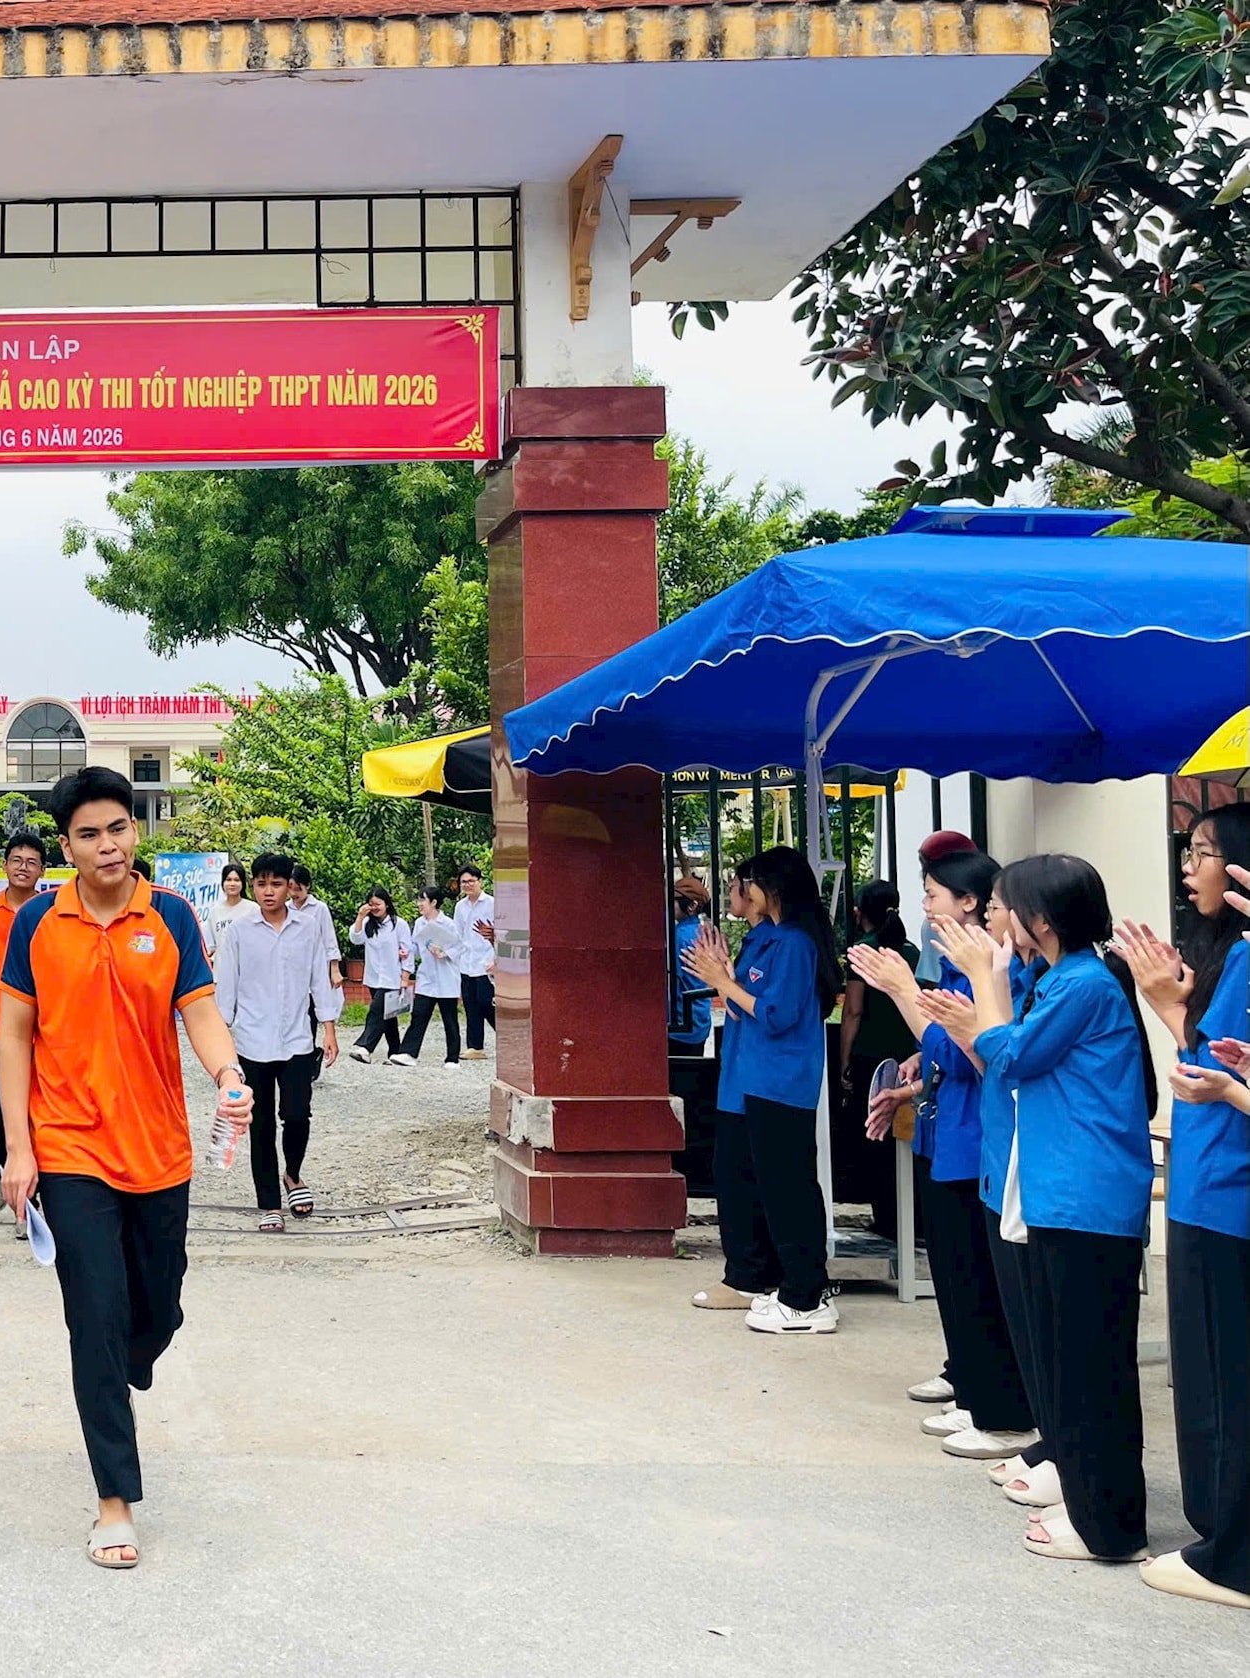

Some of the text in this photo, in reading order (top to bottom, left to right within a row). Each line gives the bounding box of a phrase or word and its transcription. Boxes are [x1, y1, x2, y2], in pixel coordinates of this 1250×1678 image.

[30, 335, 79, 364] LẬP
[19, 378, 60, 410] CAO
[67, 371, 94, 409] KỲ
[100, 377, 132, 409] THI
[139, 365, 177, 408] TỐT
[183, 370, 262, 414] NGHIỆP
[268, 375, 321, 407] THPT
[328, 368, 378, 406] NĂM
[385, 375, 437, 406] 2026
[22, 429, 31, 447] 6
[38, 423, 76, 447] NĂM
[83, 428, 122, 446] 2026
[81, 692, 91, 714] VÌ
[95, 696, 112, 718] LỢI
[116, 691, 134, 714] ÍCH
[139, 690, 170, 714] TRĂM
[174, 691, 200, 714] NĂM
[720, 769, 770, 781] MENTR
[184, 867, 204, 885] SỨC
[200, 883, 219, 904] THI
